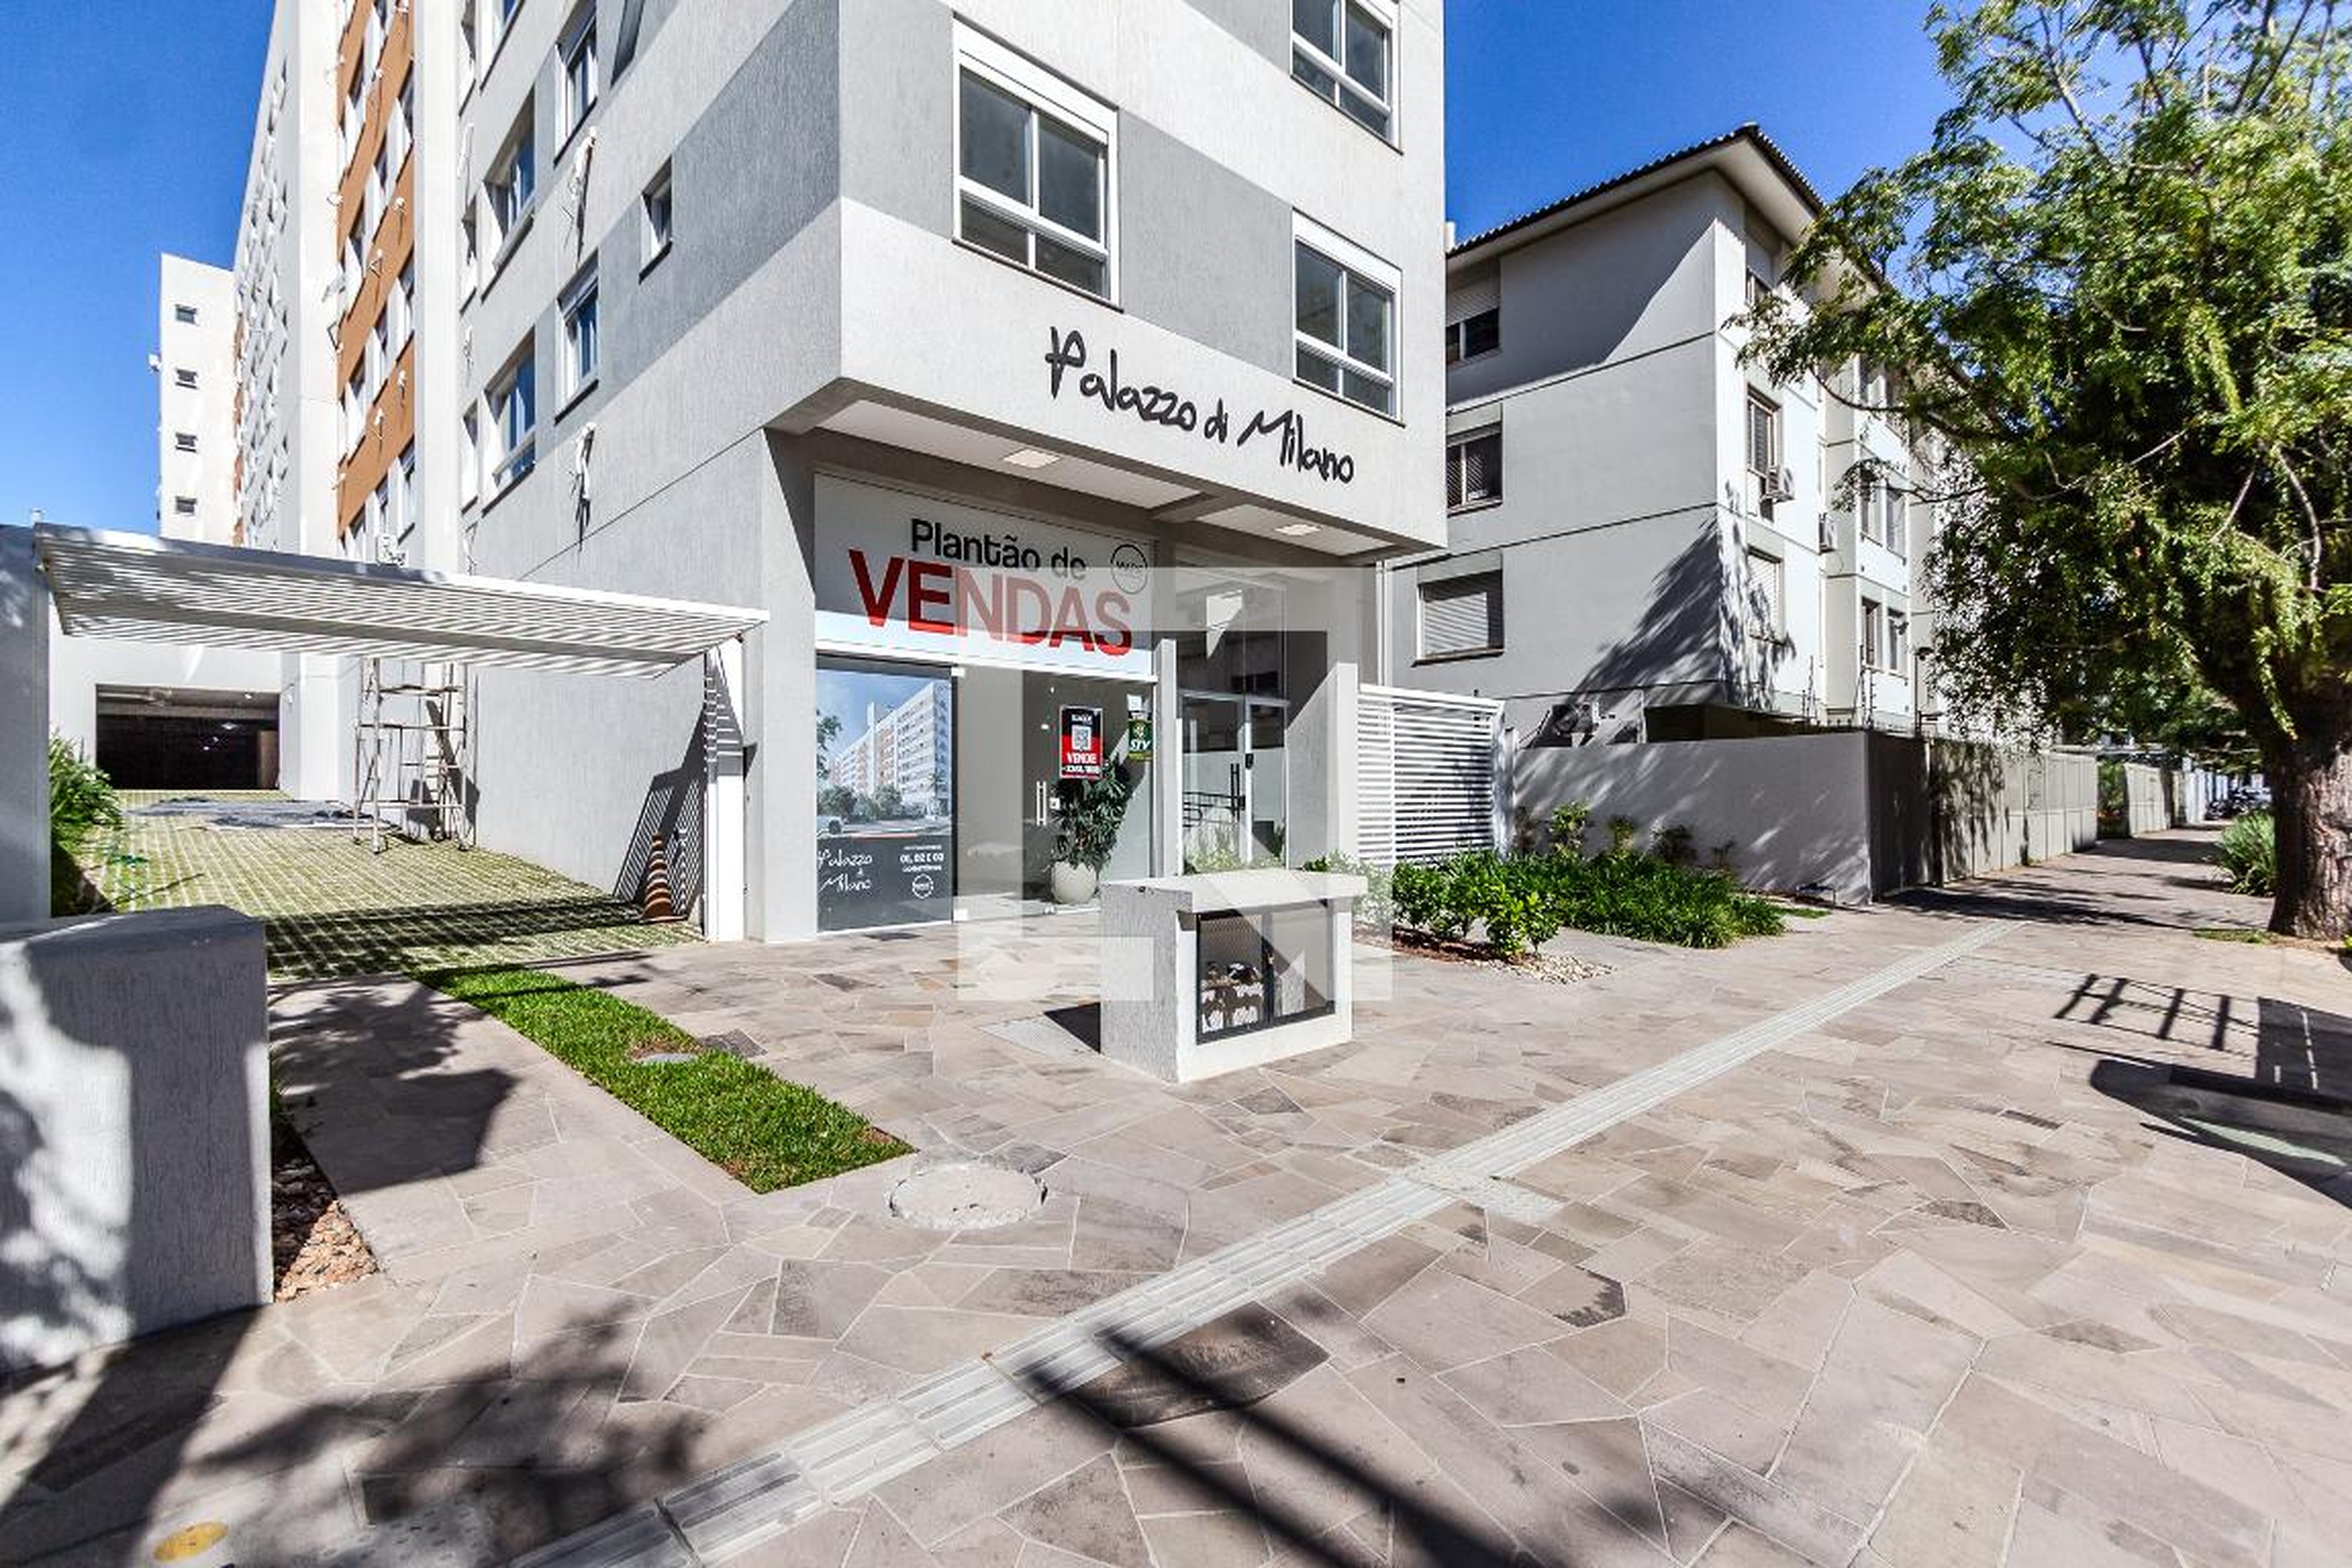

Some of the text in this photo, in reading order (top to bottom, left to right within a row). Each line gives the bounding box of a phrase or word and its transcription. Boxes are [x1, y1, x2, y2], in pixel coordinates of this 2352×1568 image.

[1045, 326, 1354, 483] Palazzo di Milano
[911, 518, 1086, 581] Plantão de
[848, 549, 1133, 657] VENDAS
[818, 849, 873, 869] Palazzo
